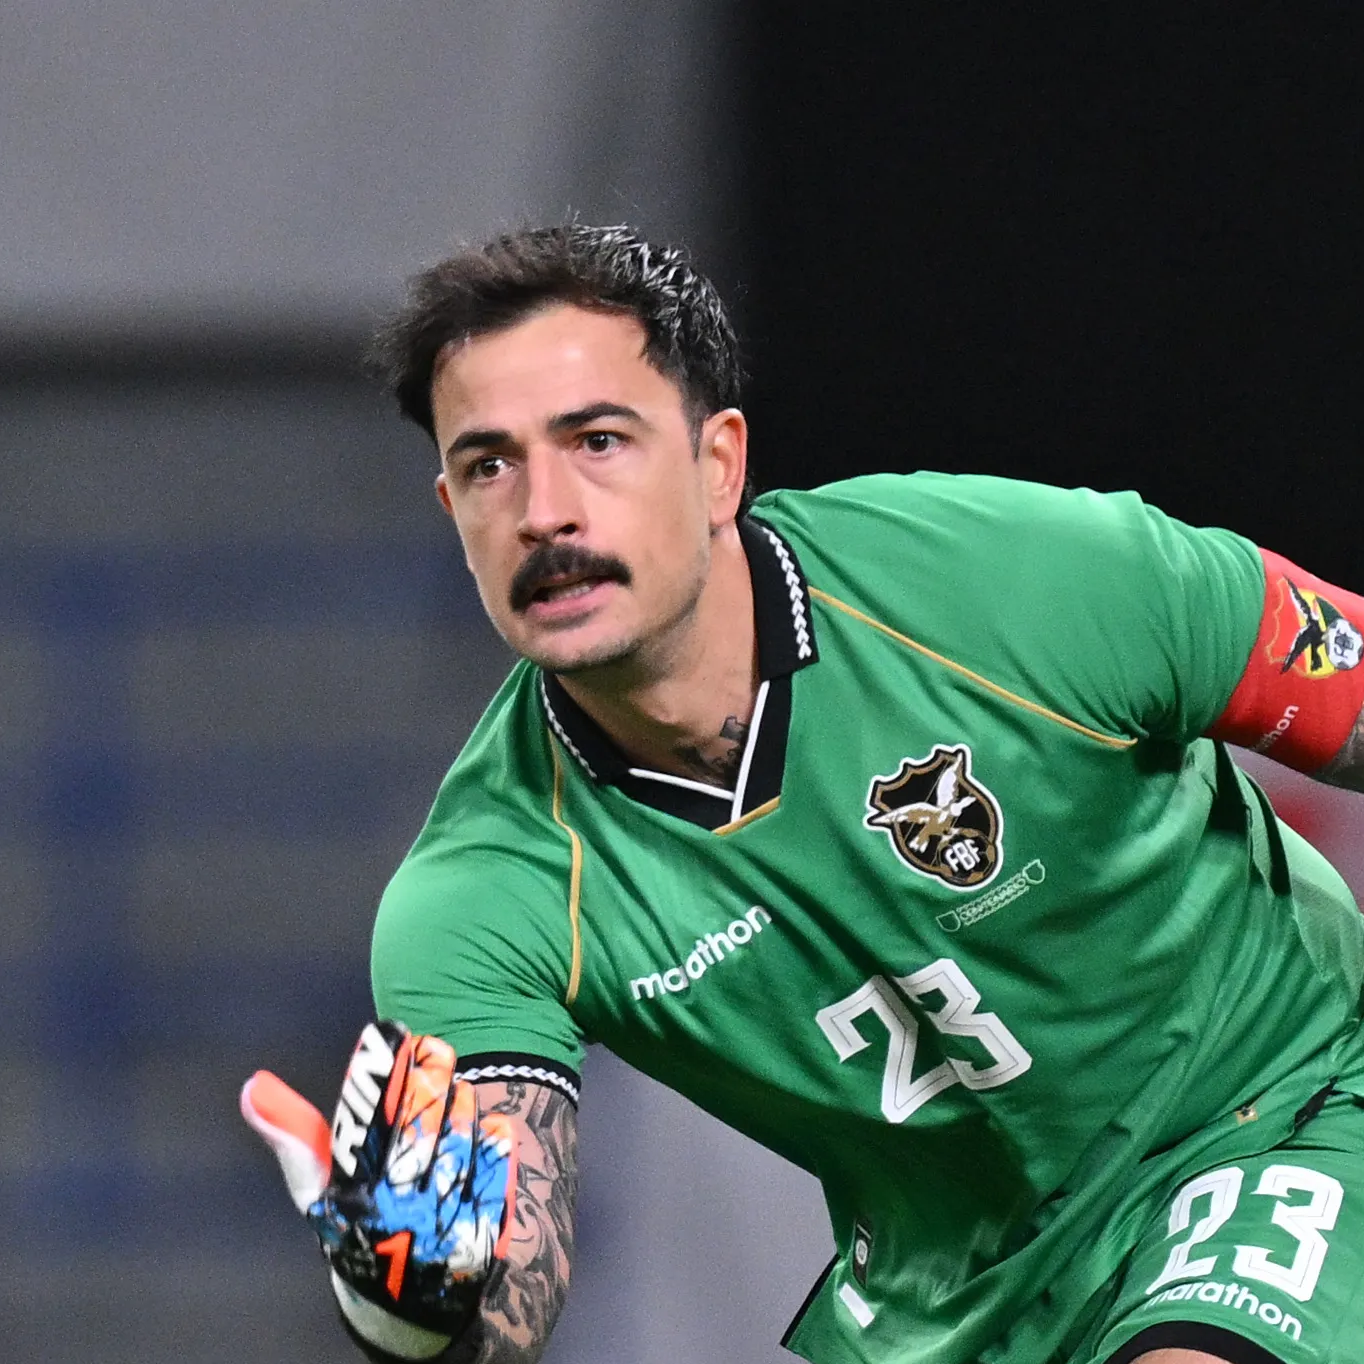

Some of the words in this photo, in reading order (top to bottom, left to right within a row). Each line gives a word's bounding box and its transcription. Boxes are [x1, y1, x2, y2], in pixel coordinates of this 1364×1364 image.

[944, 839, 981, 873] FBF
[629, 905, 773, 1001] maathon
[333, 1023, 396, 1178] RIN
[815, 958, 1033, 1124] 23
[1146, 1165, 1345, 1302] 23
